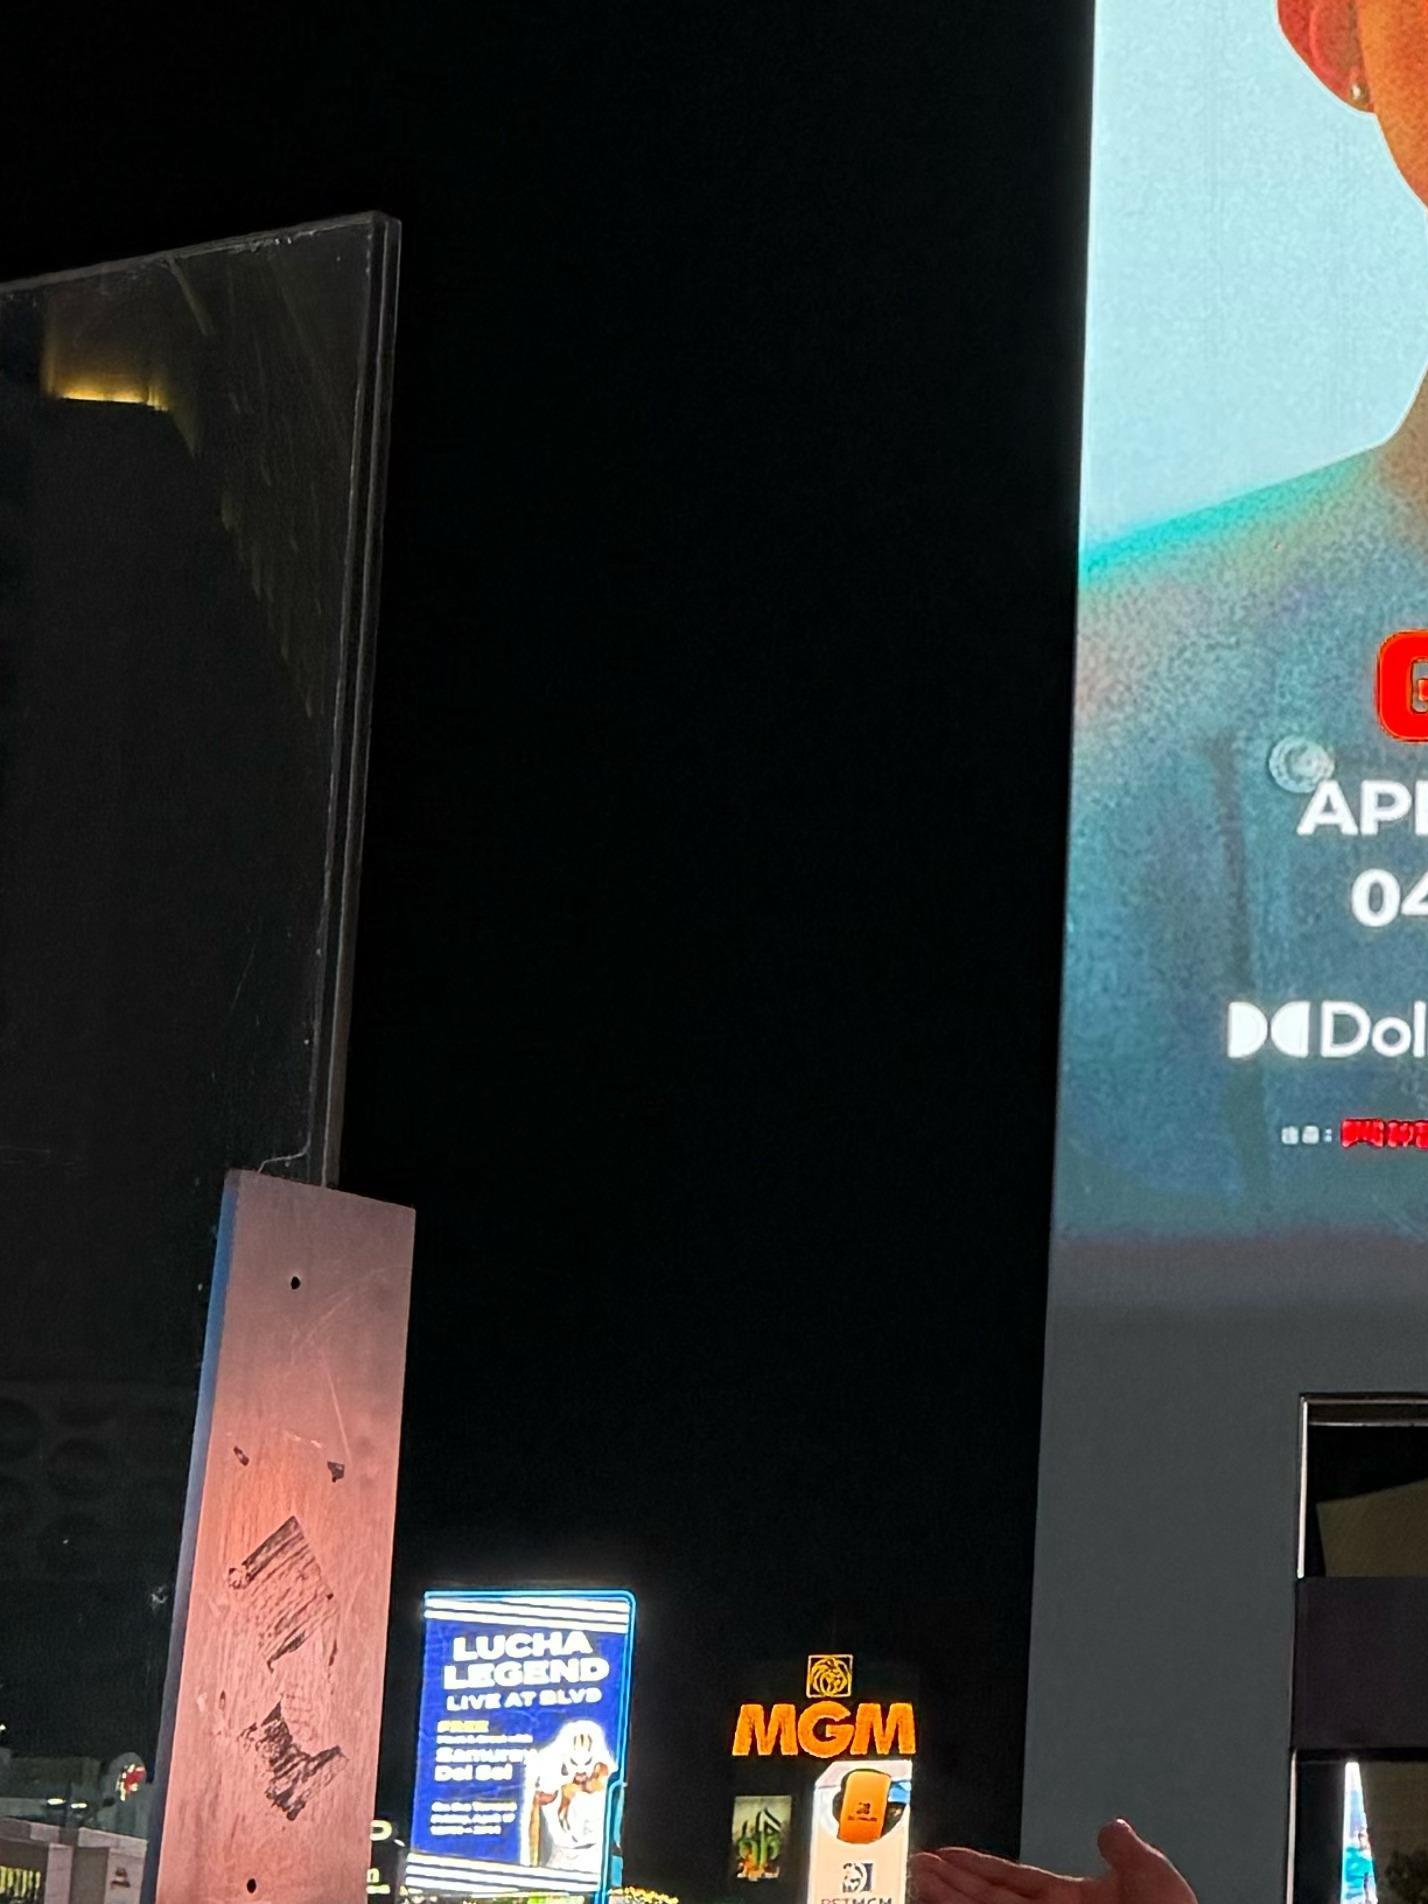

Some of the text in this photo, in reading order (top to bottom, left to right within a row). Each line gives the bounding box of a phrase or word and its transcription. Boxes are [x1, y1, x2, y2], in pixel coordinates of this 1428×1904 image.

[453, 1631, 593, 1662] LUCHA
[443, 1658, 610, 1690] LEGEND
[446, 1688, 602, 1711] LIVE AT BLVD
[732, 1701, 916, 1758] MGM
